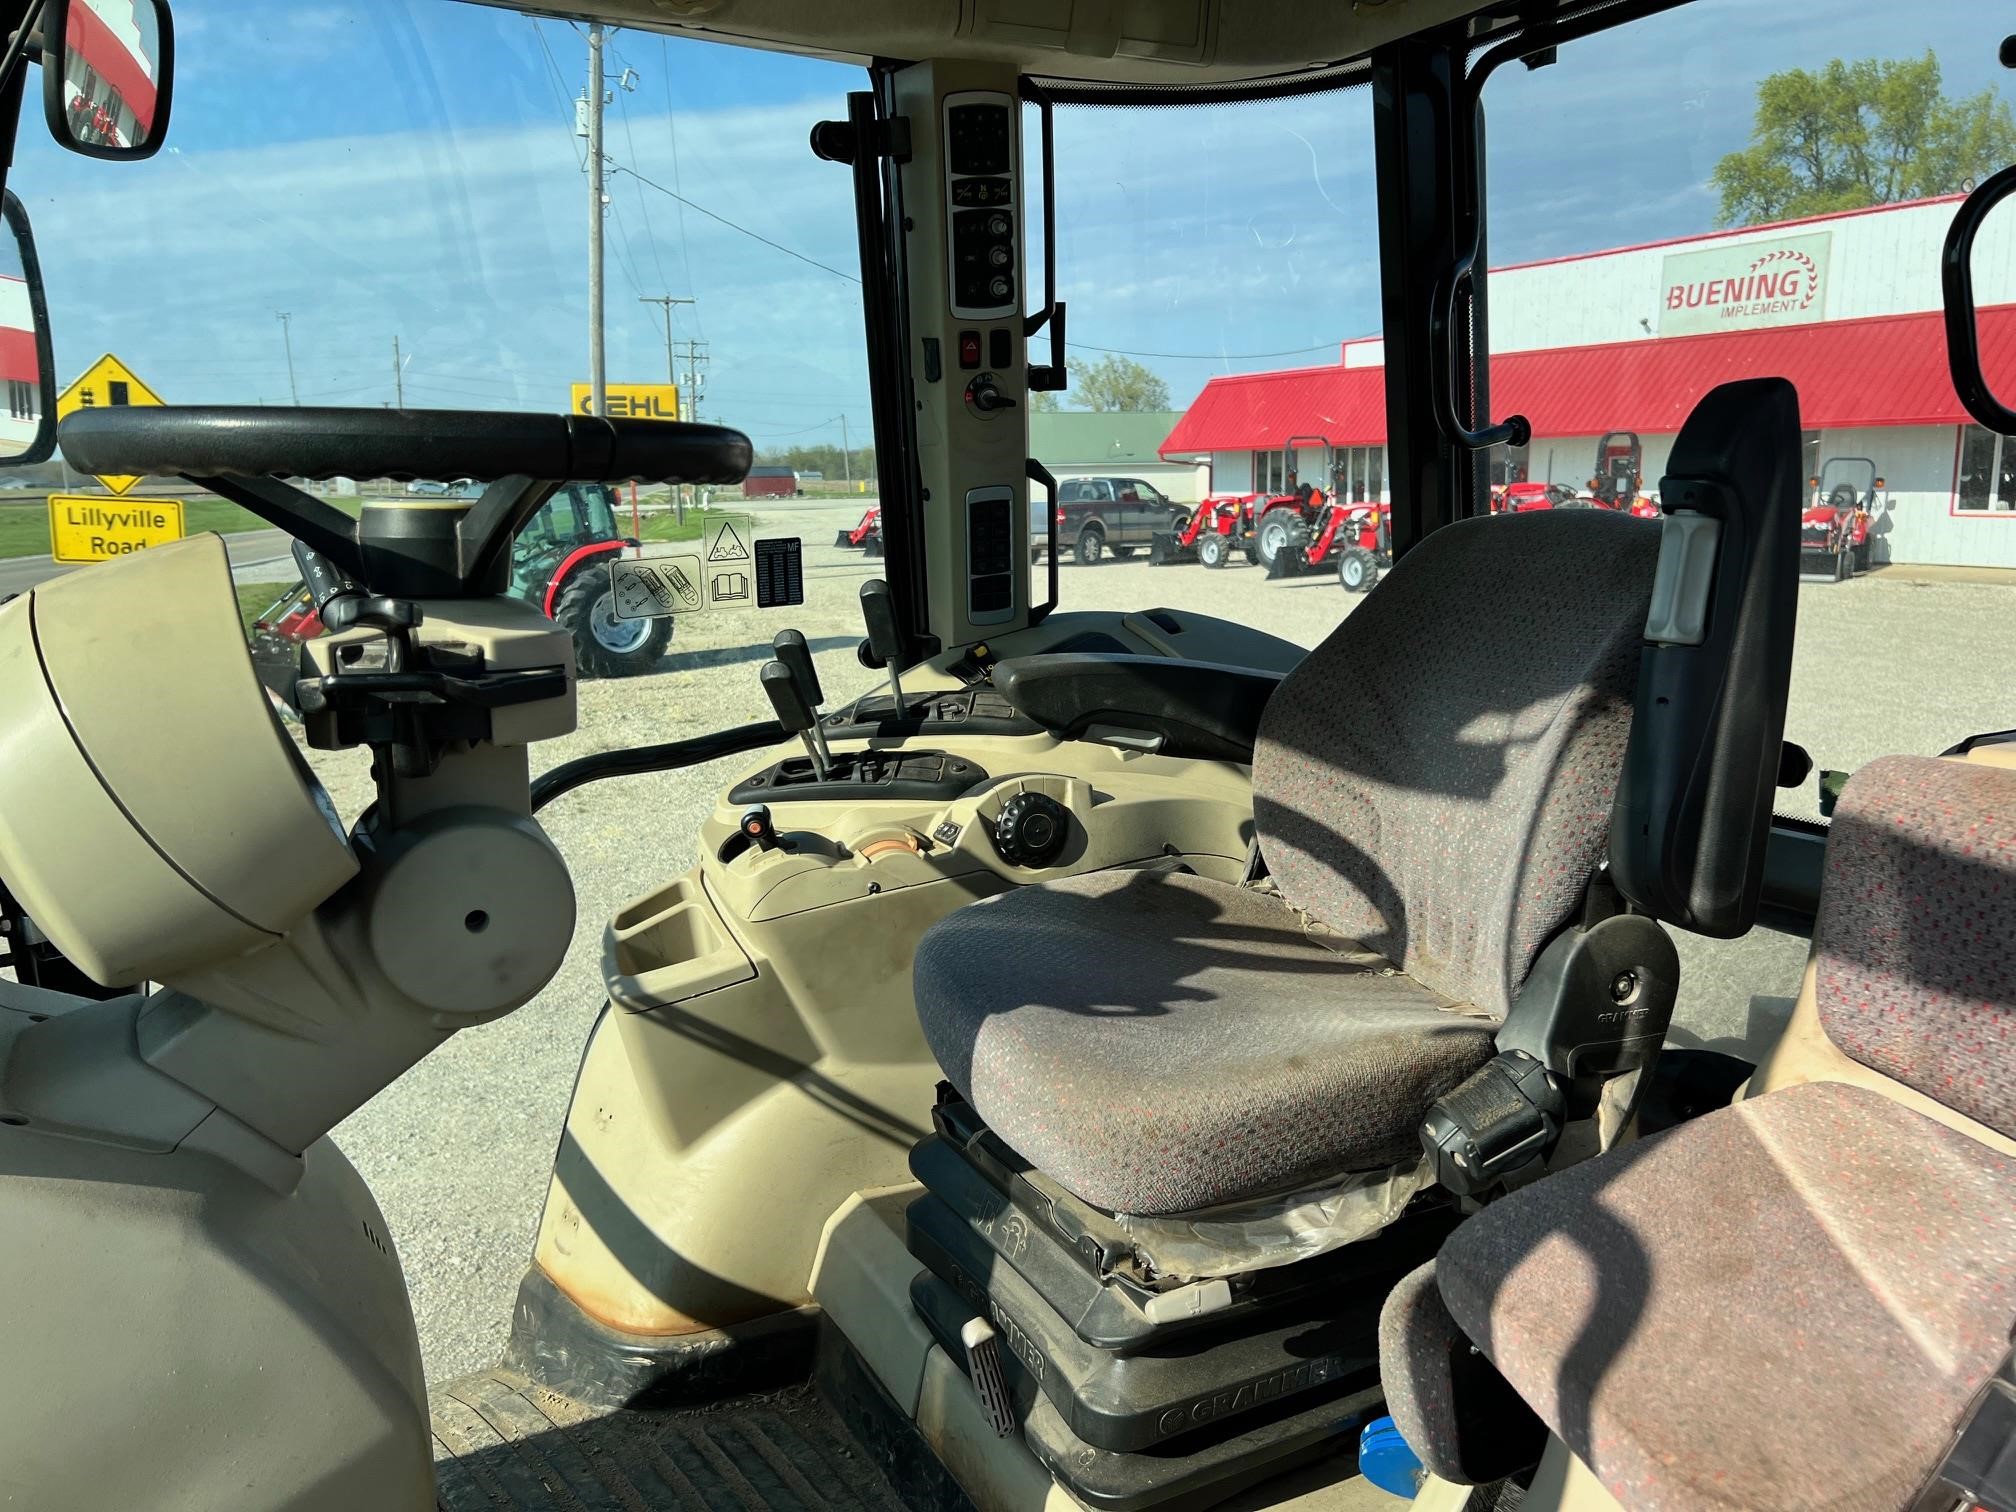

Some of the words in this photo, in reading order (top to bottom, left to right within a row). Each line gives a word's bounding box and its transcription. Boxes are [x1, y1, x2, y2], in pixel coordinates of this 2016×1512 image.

[1667, 270, 1801, 310] BUENING
[1721, 299, 1798, 318] IMPLEMENT
[67, 507, 166, 530] Lillyville
[91, 537, 146, 555] Road
[787, 542, 800, 552] MF
[1597, 1008, 1649, 1023] GRAMMER
